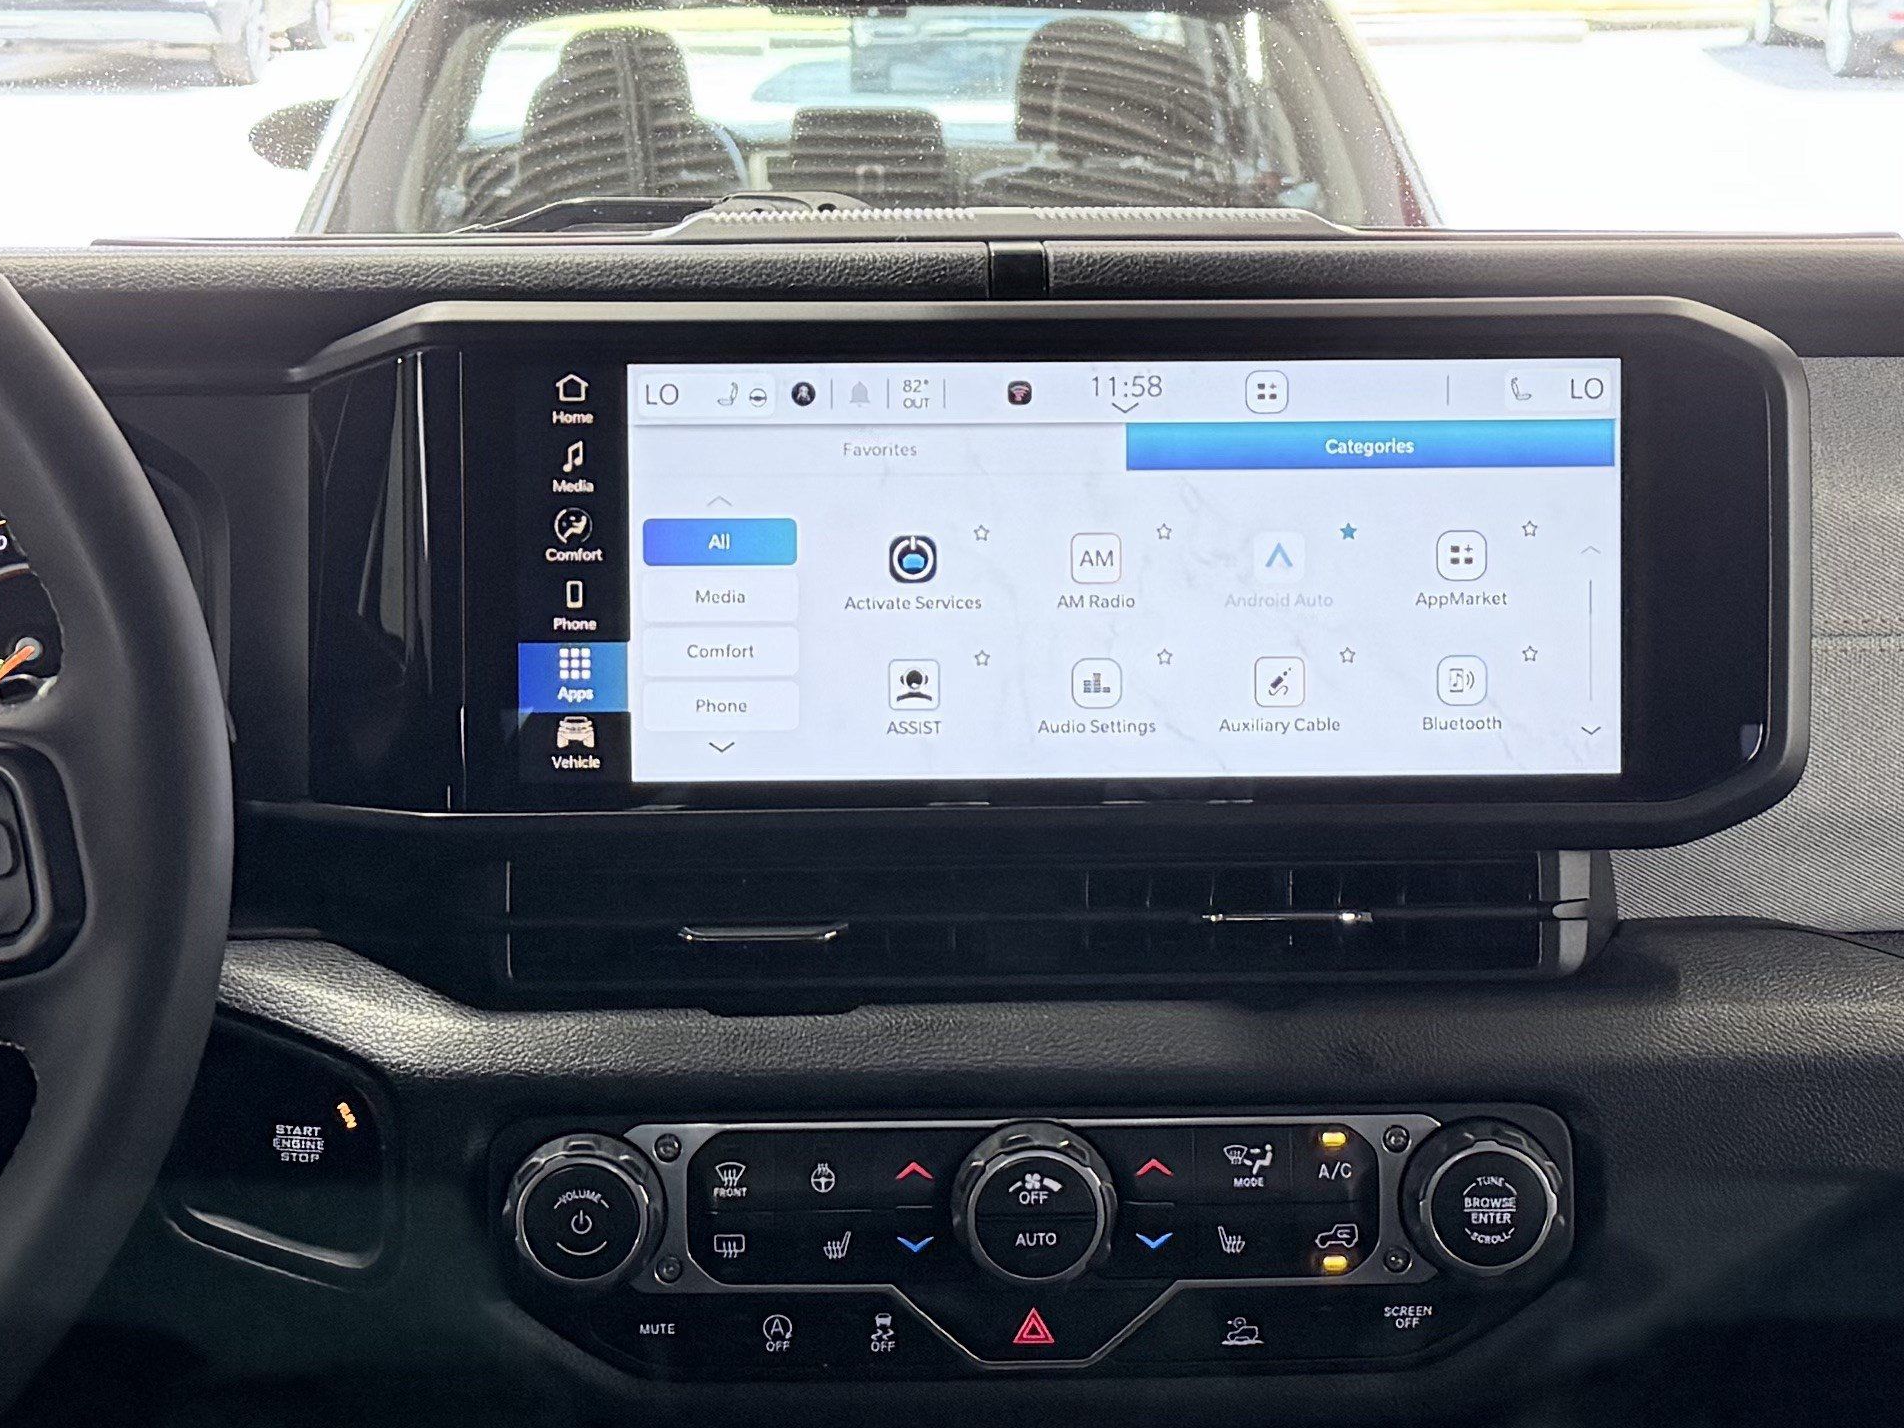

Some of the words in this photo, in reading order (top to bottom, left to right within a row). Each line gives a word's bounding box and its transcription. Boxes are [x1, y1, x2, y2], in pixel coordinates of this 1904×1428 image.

[645, 383, 679, 405] LO
[1091, 375, 1163, 398] 11:58
[1569, 377, 1605, 400] LO
[902, 397, 931, 409] OUT
[552, 410, 594, 424] Home
[842, 441, 918, 458] Favorites
[1324, 438, 1416, 457] Categories
[552, 479, 595, 494] Media
[708, 533, 731, 551] All
[545, 548, 603, 562] Comfort
[1079, 549, 1115, 568] AM
[695, 589, 746, 604] Media
[844, 595, 911, 610] Activate
[915, 595, 983, 610] Services
[1057, 595, 1085, 609] AM
[1089, 595, 1136, 609] Radio
[1224, 593, 1292, 609] Android
[1294, 593, 1334, 609] Auto
[1415, 592, 1508, 609] AppMarket
[553, 617, 598, 632] Phone
[686, 644, 755, 660] Comfort
[557, 686, 595, 703] Apps
[695, 698, 748, 713] Phone
[886, 721, 942, 736] ASSIST
[1037, 719, 1087, 734] Audio
[1089, 719, 1157, 738] Settings
[1218, 718, 1291, 735] Auxiliary
[1294, 718, 1341, 733] Cable
[1421, 716, 1503, 731] Bluetooth
[551, 755, 602, 770] Vehicle
[275, 1124, 322, 1137] START
[272, 1137, 325, 1151] ENGINE
[280, 1152, 320, 1163] STOP
[1318, 1162, 1353, 1180] A/C
[1233, 1177, 1264, 1188] MODE
[1476, 1175, 1505, 1188] TUNE
[558, 1189, 603, 1205] VOLUME
[713, 1186, 748, 1198] FRONT
[1018, 1191, 1049, 1205] OFF
[1463, 1196, 1517, 1209] BROWSE
[1471, 1212, 1512, 1224] ENTER
[1015, 1232, 1058, 1247] AUTO
[1469, 1230, 1511, 1245] SCROLL
[1383, 1306, 1433, 1317] SCREEN
[639, 1323, 676, 1335] MUTE
[770, 1318, 783, 1333] A
[1395, 1318, 1420, 1329] OFF
[765, 1340, 791, 1352] OFF
[870, 1340, 896, 1352] OFF
